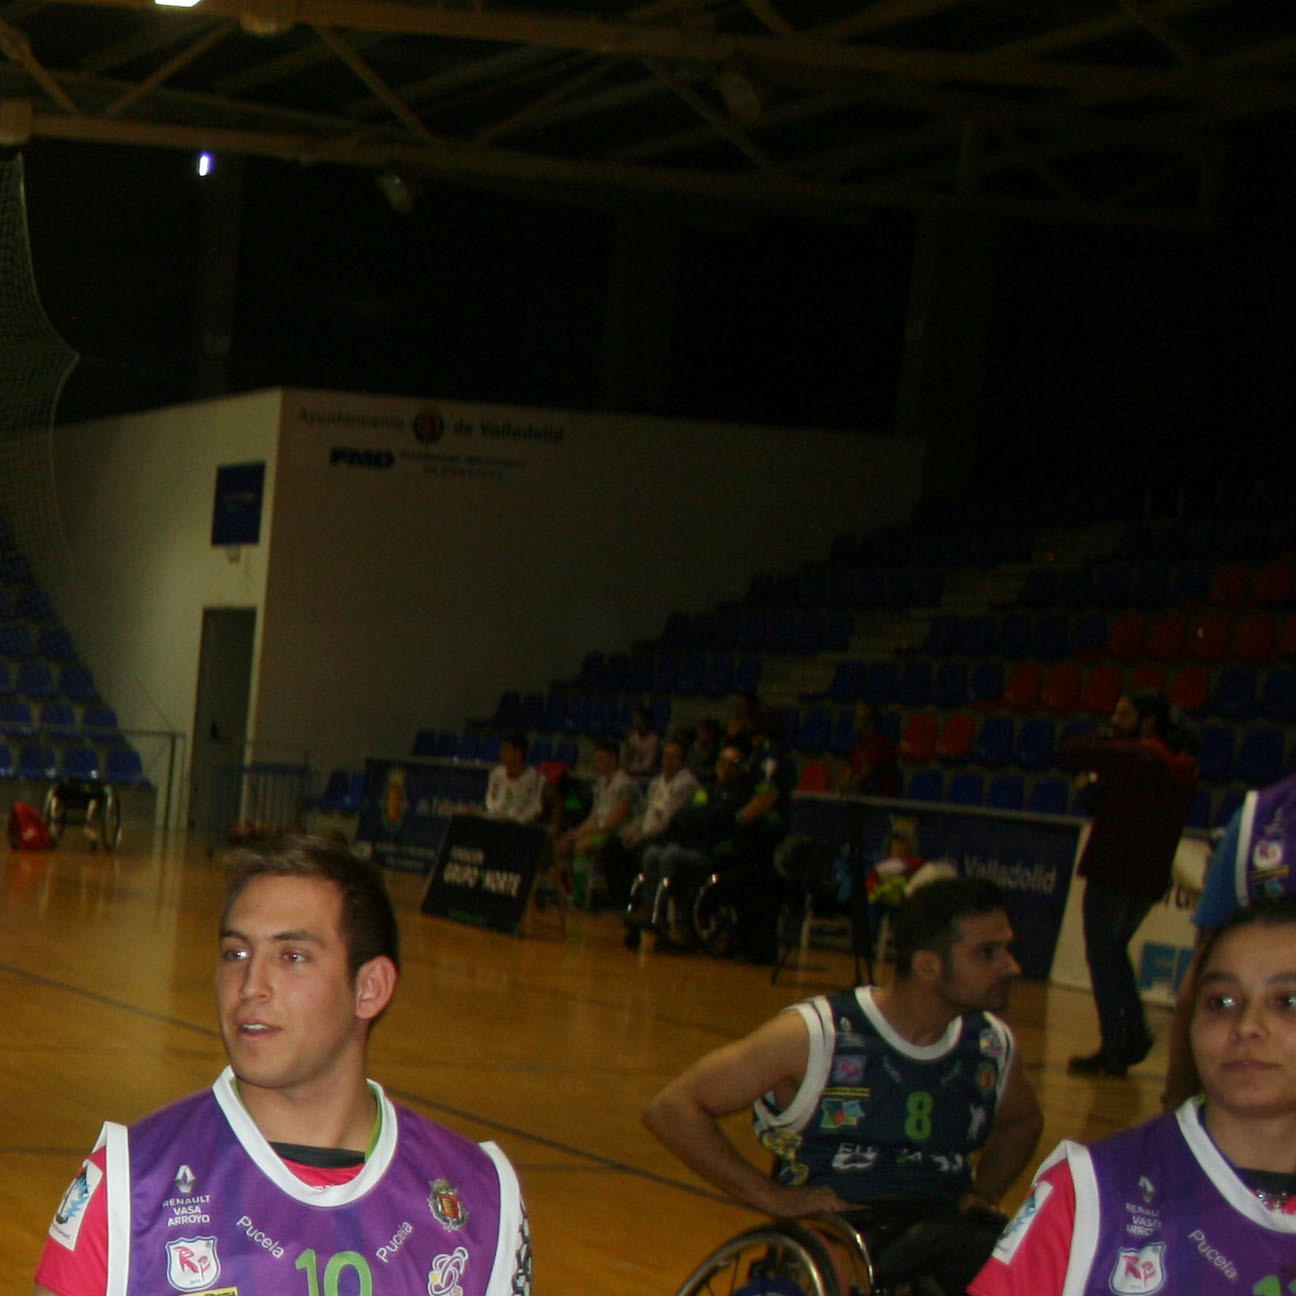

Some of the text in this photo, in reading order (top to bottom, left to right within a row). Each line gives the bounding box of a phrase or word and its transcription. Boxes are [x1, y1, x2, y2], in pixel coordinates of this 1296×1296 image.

[904, 1090, 934, 1142] 8
[162, 1195, 211, 1207] RENAULT
[167, 1214, 211, 1227] ARROYO
[173, 1205, 202, 1216] VASA
[236, 1215, 285, 1259] Pucela
[375, 1220, 414, 1263] Pucela
[1187, 1228, 1238, 1280] Pucela
